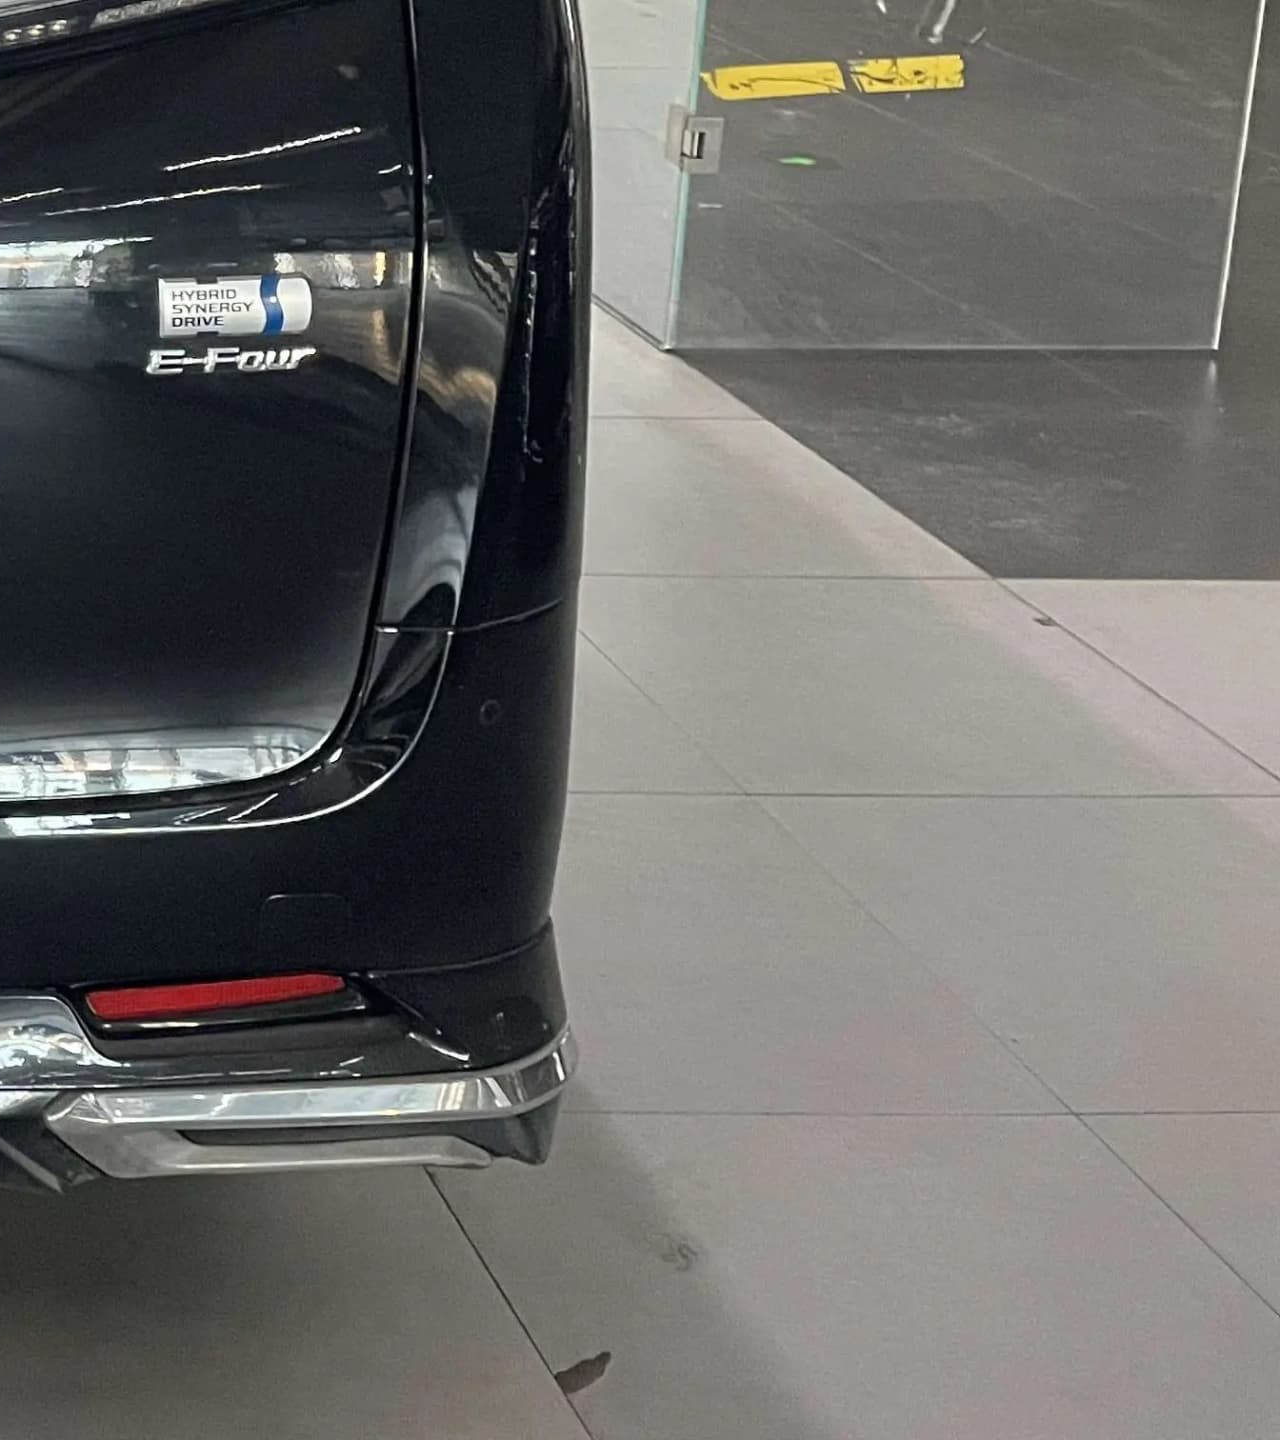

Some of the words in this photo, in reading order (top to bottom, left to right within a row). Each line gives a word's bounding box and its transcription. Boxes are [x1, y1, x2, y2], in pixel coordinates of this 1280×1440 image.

[171, 288, 237, 301] HYBRID
[171, 301, 255, 314] SYNERGY
[171, 315, 225, 328] DRIVE
[145, 346, 317, 376] E-Four
